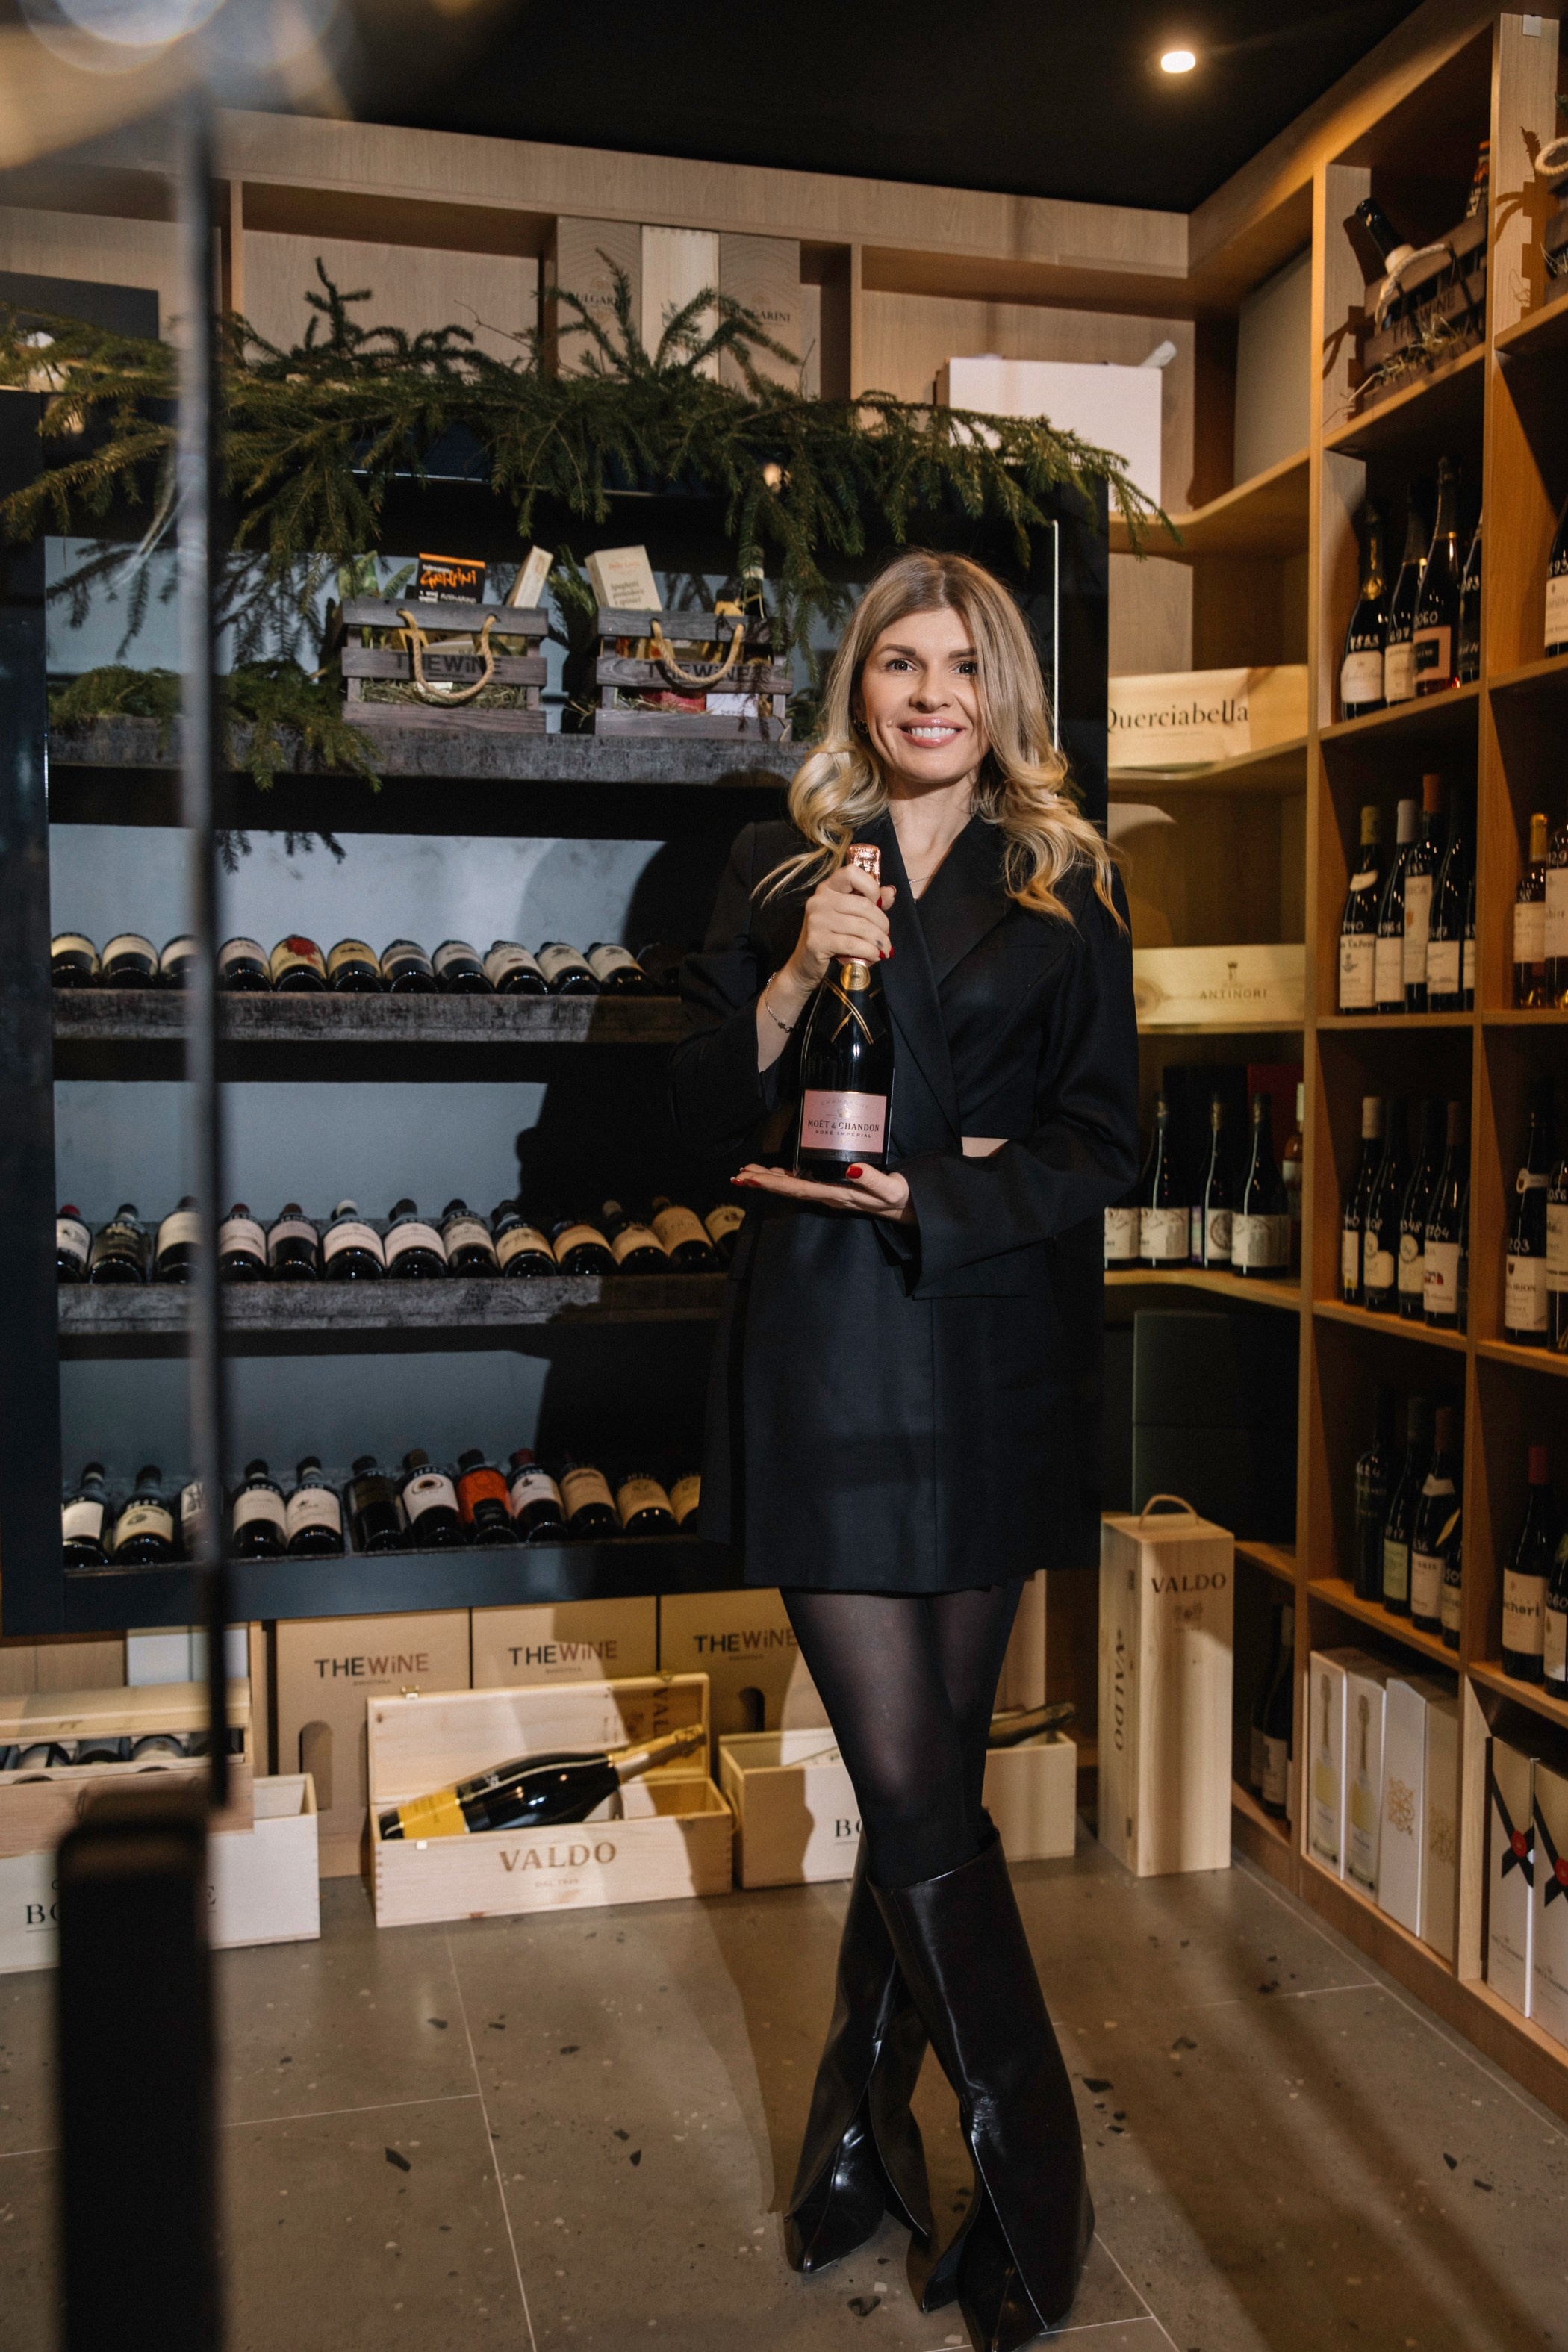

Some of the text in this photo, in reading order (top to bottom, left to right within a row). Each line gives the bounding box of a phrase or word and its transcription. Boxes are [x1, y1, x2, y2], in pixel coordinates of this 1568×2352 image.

[1199, 988, 1266, 1000] ANTINORI
[808, 1119, 830, 1129] MOËT
[838, 1121, 880, 1133] CHANDON
[1151, 1572, 1227, 1593] VALDO
[1114, 1643, 1125, 1752] VALDO
[653, 1687, 669, 1738] VAL
[499, 1841, 617, 1873] VALDO
